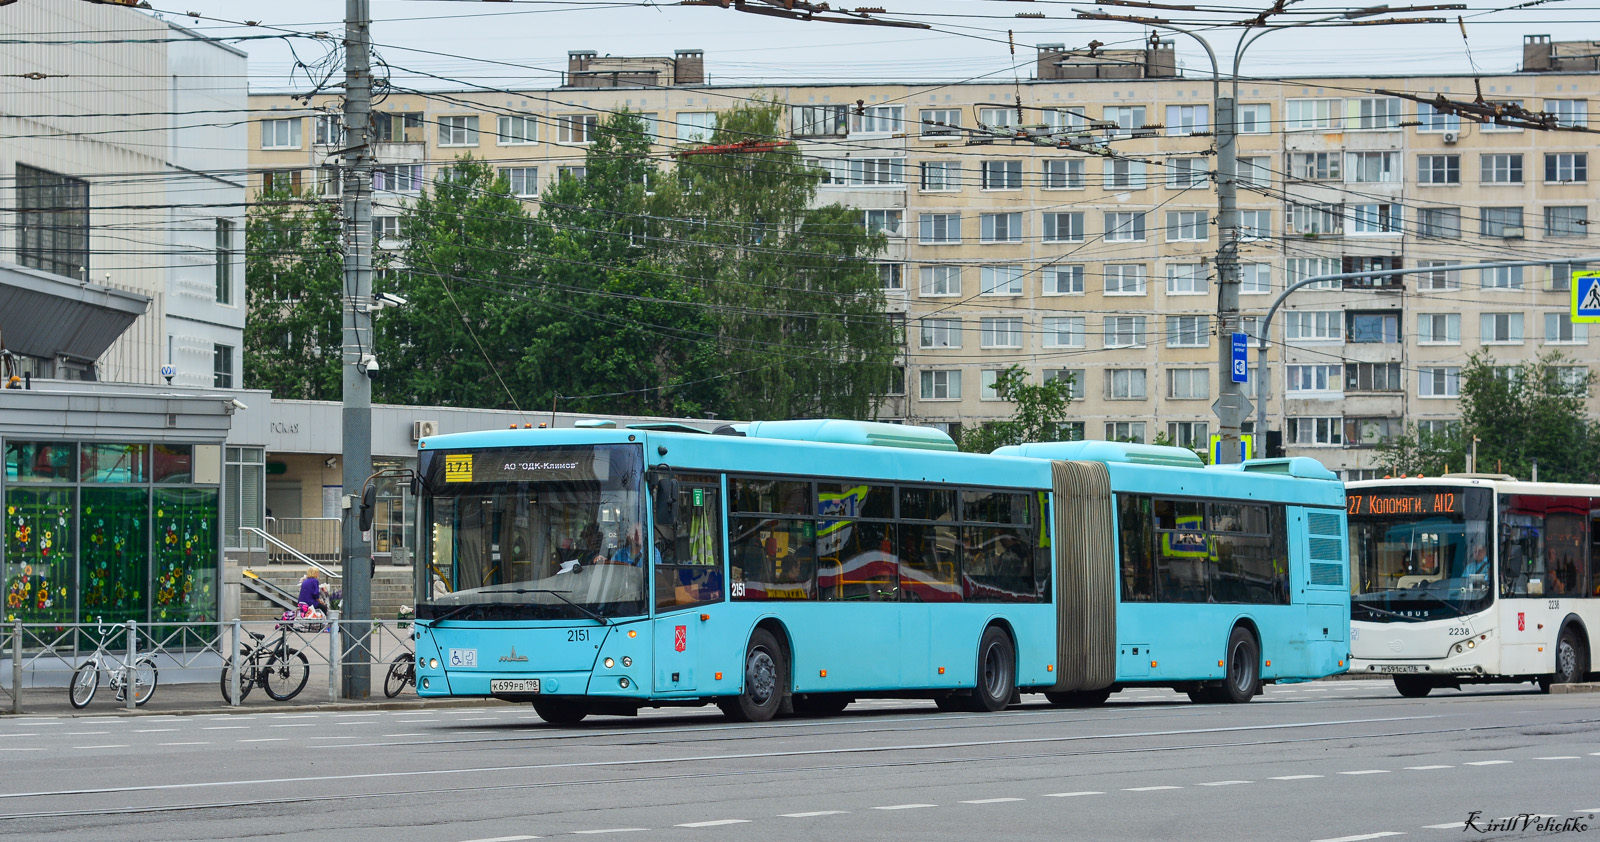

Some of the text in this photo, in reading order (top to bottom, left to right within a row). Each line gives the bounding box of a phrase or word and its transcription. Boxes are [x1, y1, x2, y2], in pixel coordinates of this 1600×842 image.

[447, 462, 471, 473] 171
[731, 583, 746, 597] 2151
[567, 629, 590, 642] 2151
[1448, 627, 1470, 636] 2238
[493, 680, 537, 691] К699РВ 198
